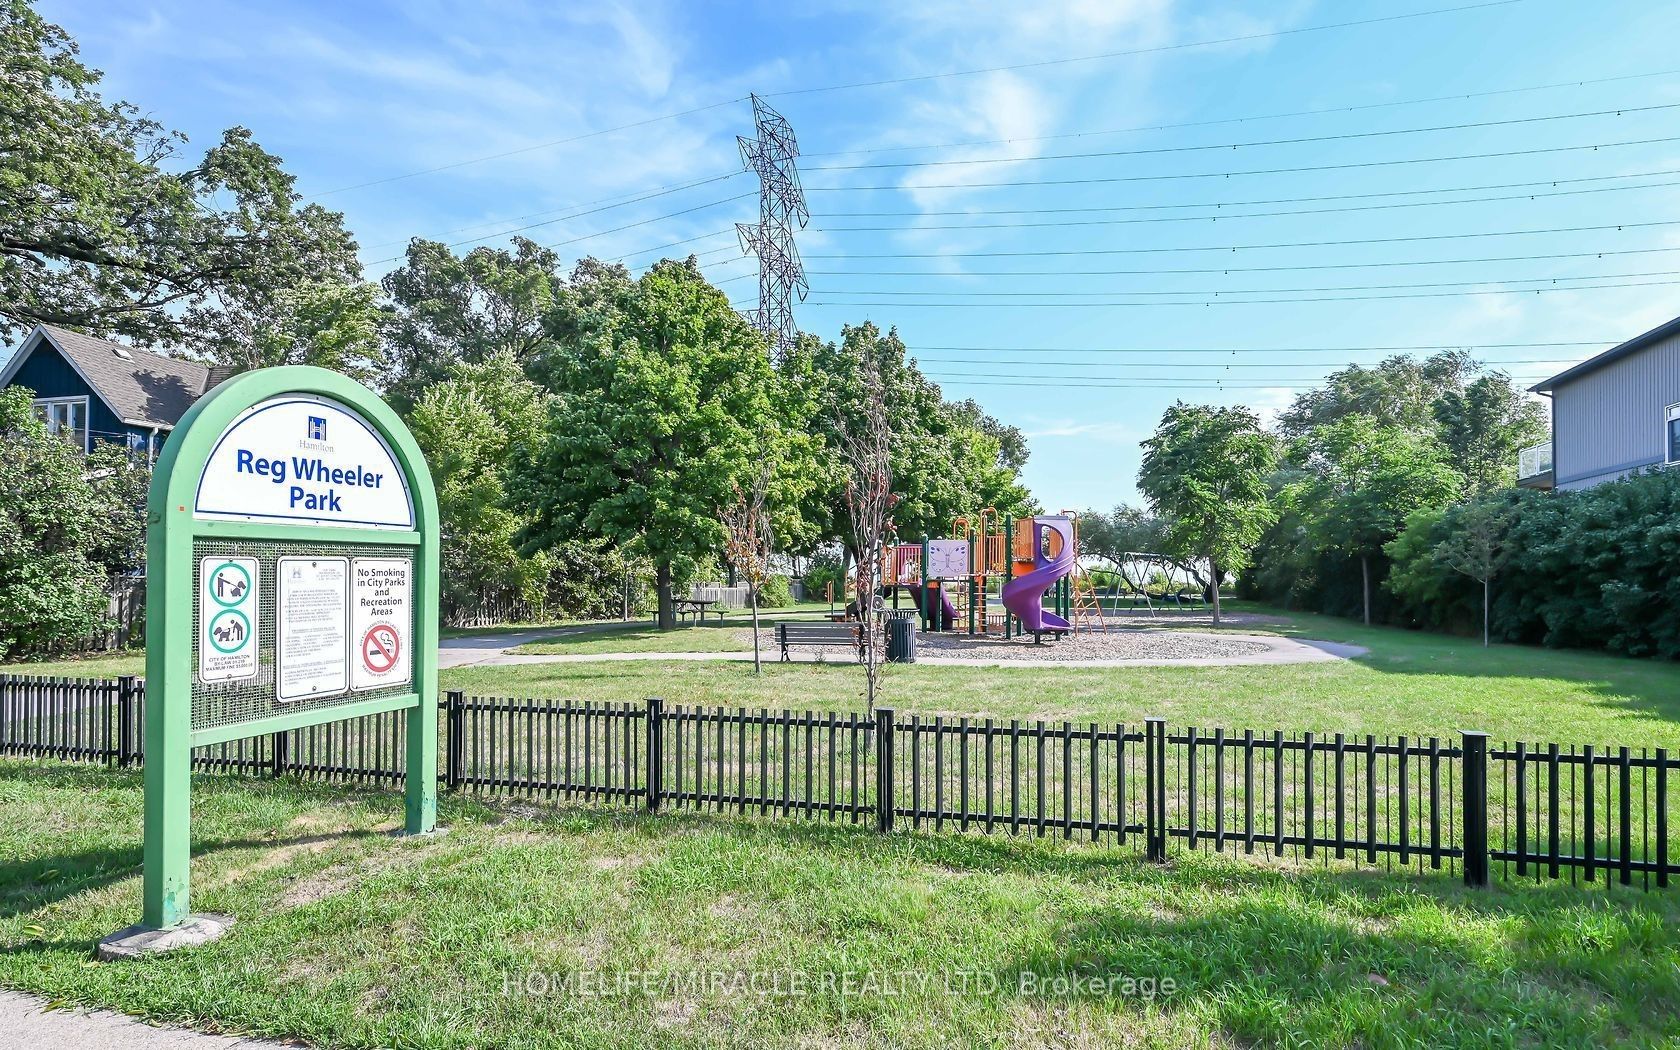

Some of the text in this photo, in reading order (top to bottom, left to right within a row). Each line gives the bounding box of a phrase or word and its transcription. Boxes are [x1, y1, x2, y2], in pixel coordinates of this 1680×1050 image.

[299, 440, 334, 453] Hamilton
[237, 449, 384, 489] Reg Wheeler
[290, 486, 342, 512] Park
[357, 568, 405, 579] No Smoking
[357, 577, 405, 588] in City Parks
[374, 587, 390, 596] and
[360, 596, 403, 607] Recreation
[370, 607, 393, 616] Areas
